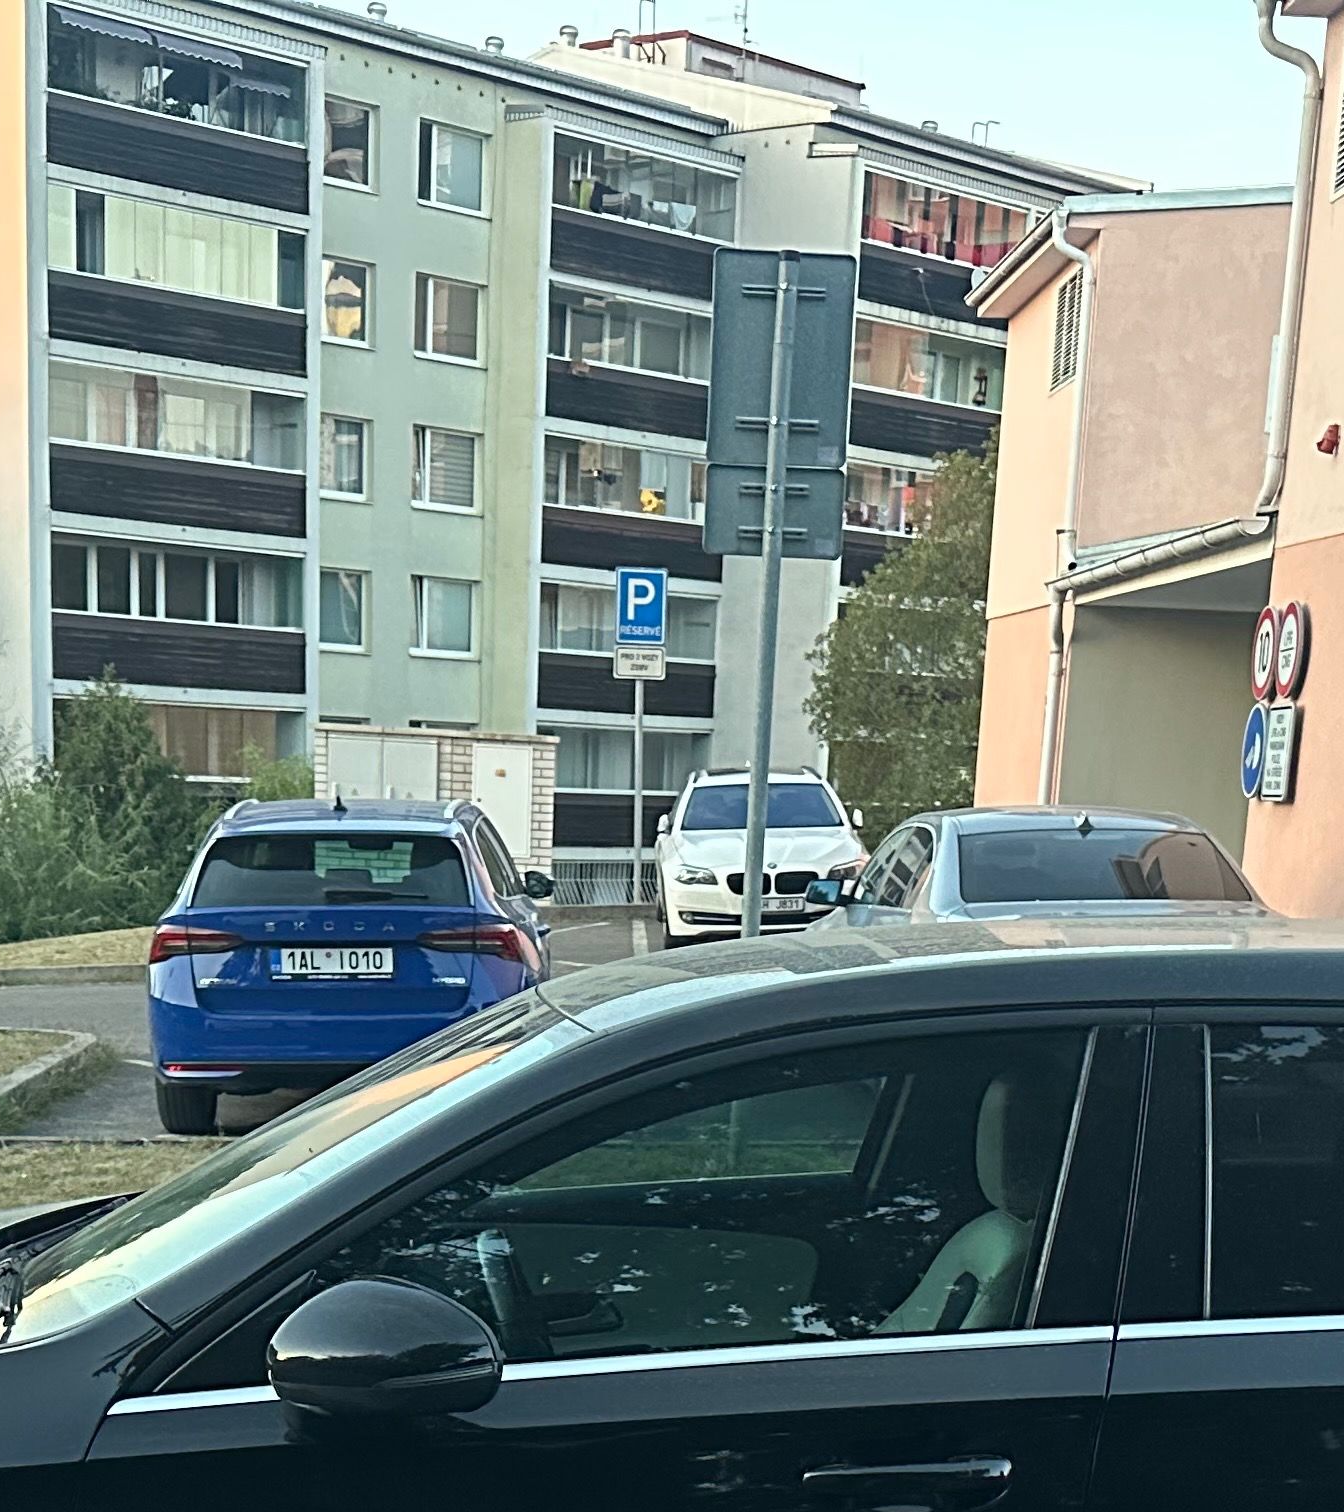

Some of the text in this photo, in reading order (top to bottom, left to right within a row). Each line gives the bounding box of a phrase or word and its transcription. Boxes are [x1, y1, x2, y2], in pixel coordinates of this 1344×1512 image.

[627, 577, 656, 621] P
[1258, 630, 1270, 673] 10
[287, 951, 321, 971] 1AL
